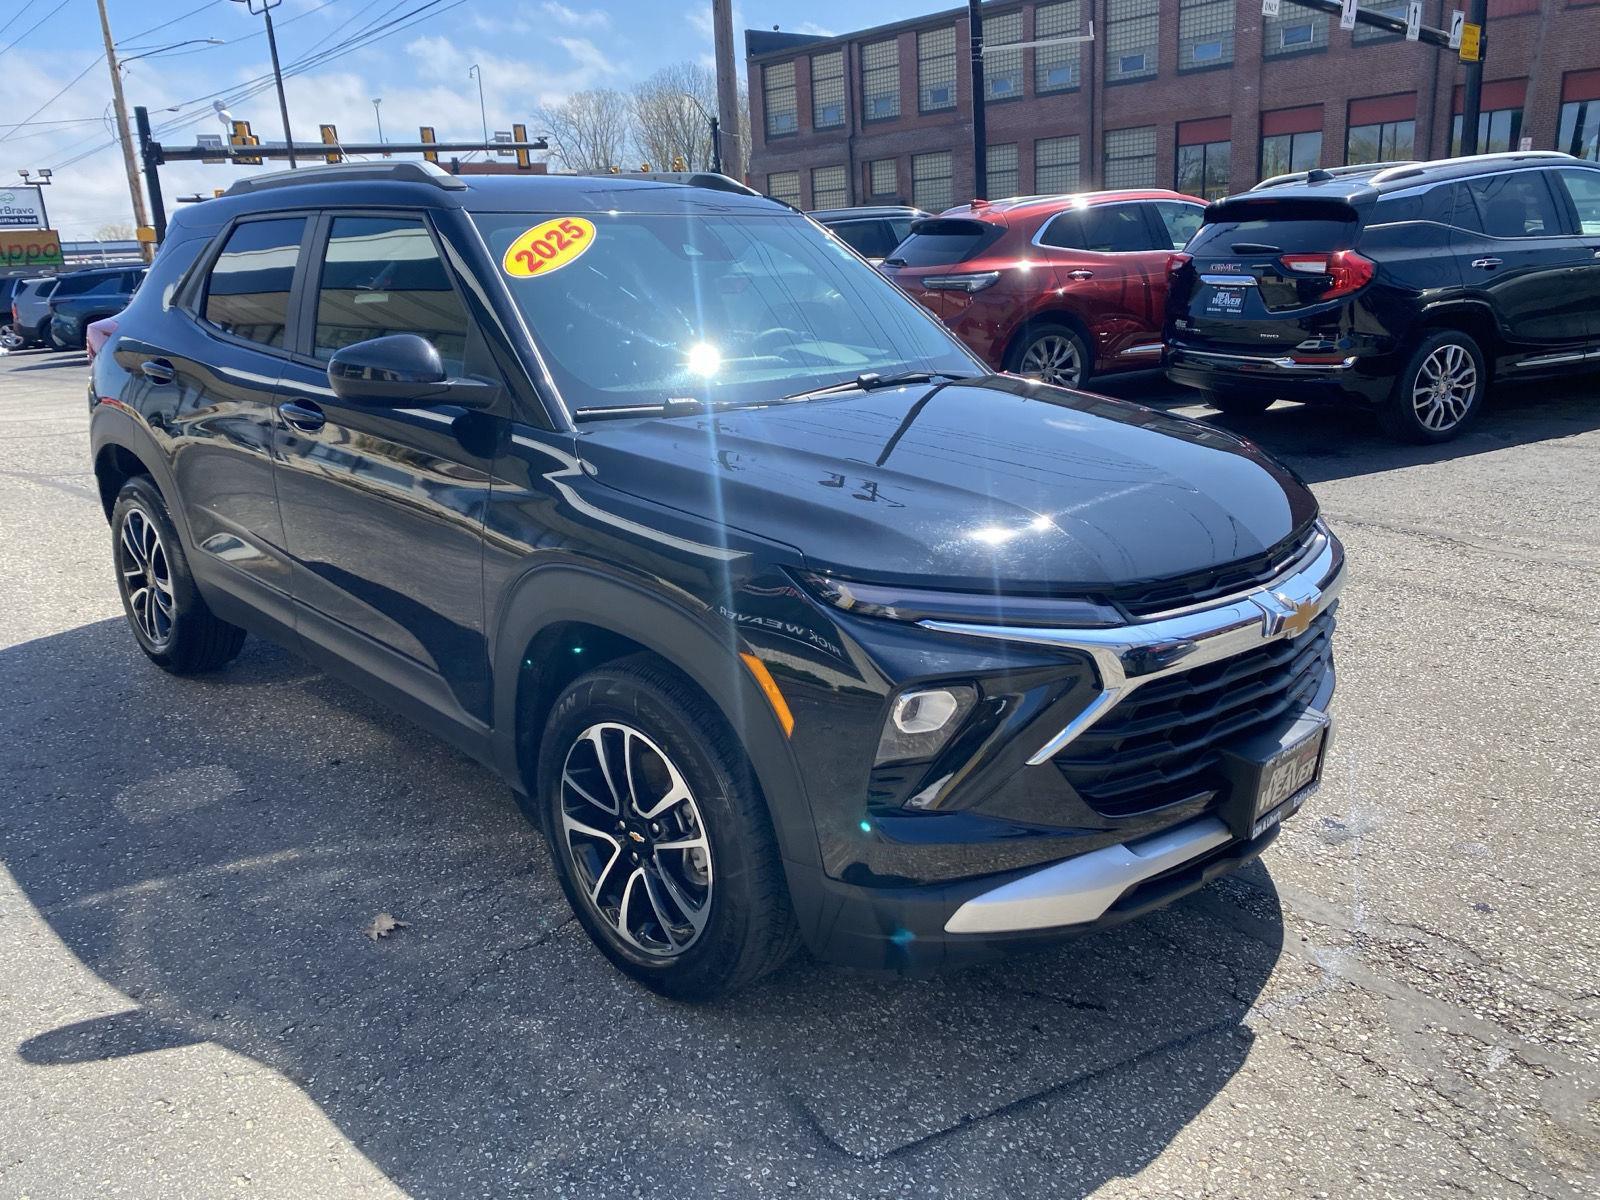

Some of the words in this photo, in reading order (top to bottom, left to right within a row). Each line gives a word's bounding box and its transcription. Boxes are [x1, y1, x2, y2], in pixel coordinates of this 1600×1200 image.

[1264, 2, 1278, 13] ONLY
[1342, 14, 1354, 25] ONLY
[515, 220, 585, 272] 2025
[1209, 263, 1242, 273] GMC
[1259, 755, 1318, 811] WEAVER
